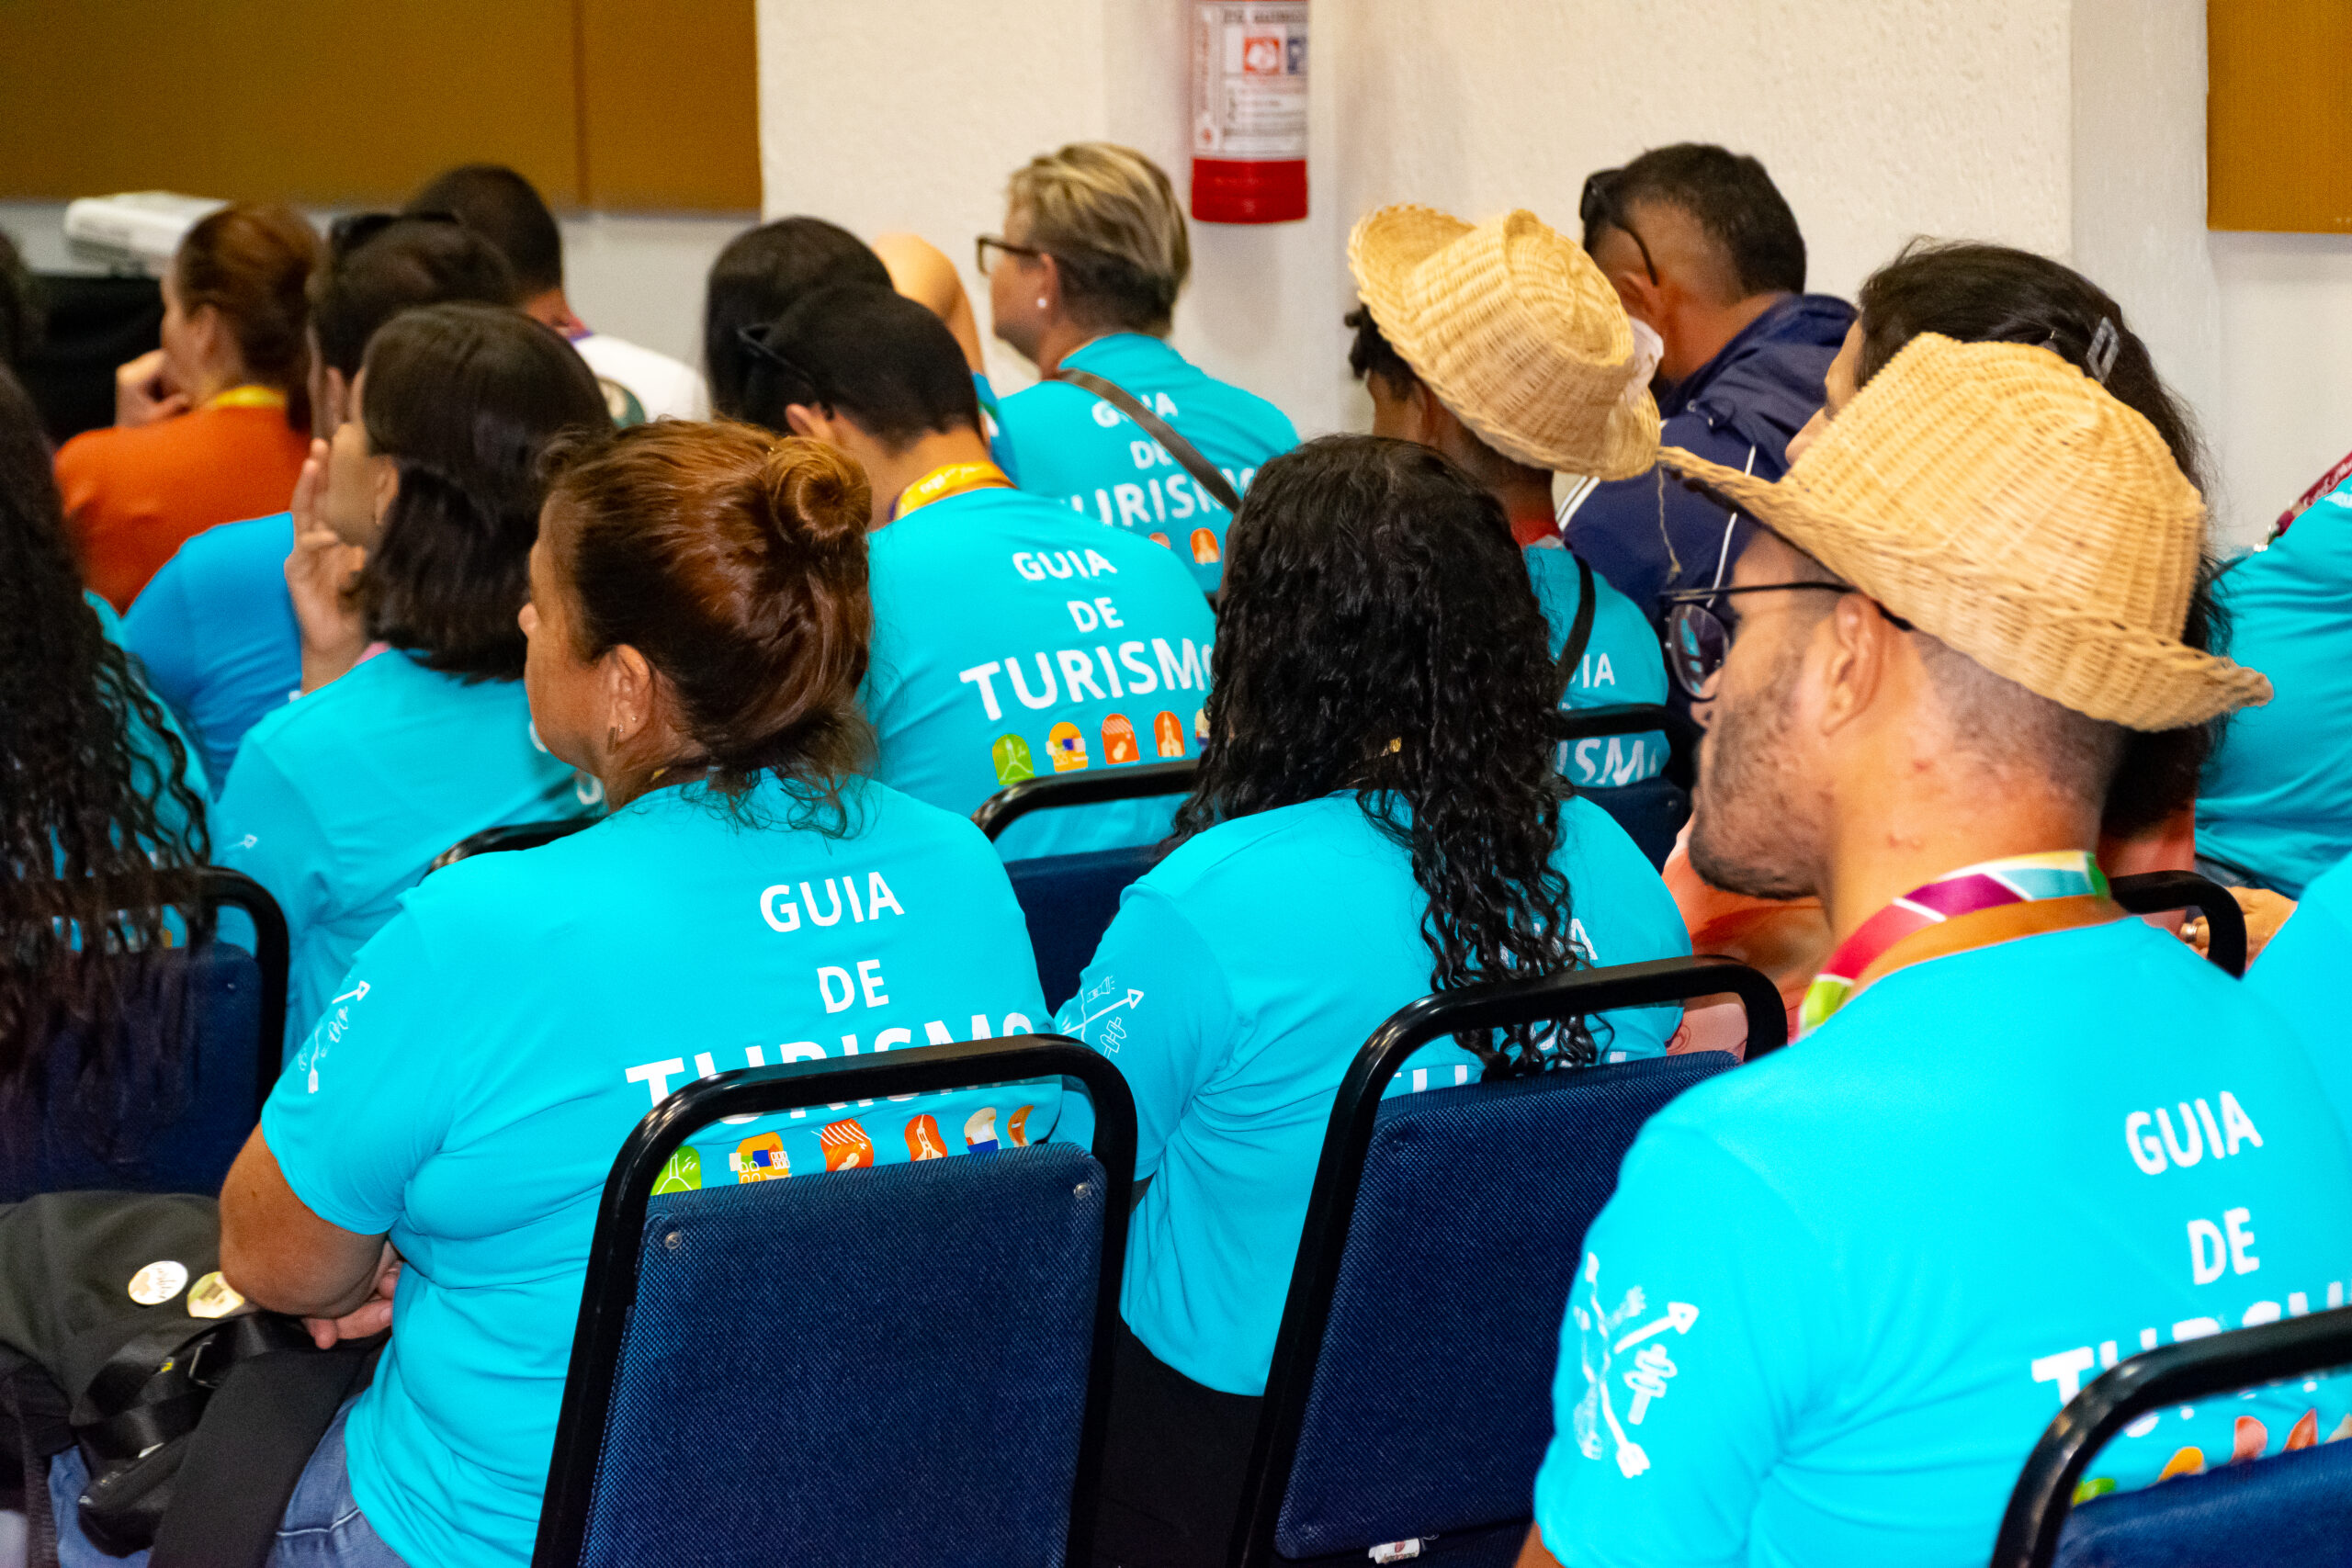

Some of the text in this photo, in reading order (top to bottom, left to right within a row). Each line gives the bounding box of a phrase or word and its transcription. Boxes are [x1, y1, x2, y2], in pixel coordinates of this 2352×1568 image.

[1091, 391, 1179, 428] GA
[1059, 467, 1255, 527] URIS
[1012, 548, 1118, 581] GUIA
[1067, 596, 1125, 633] DE
[958, 637, 1213, 721] TURISM
[1570, 652, 1616, 689] IA
[760, 871, 905, 933] GUIA
[816, 958, 889, 1014] DE
[2125, 1090, 2264, 1176] GUIA
[2187, 1207, 2260, 1285] DE
